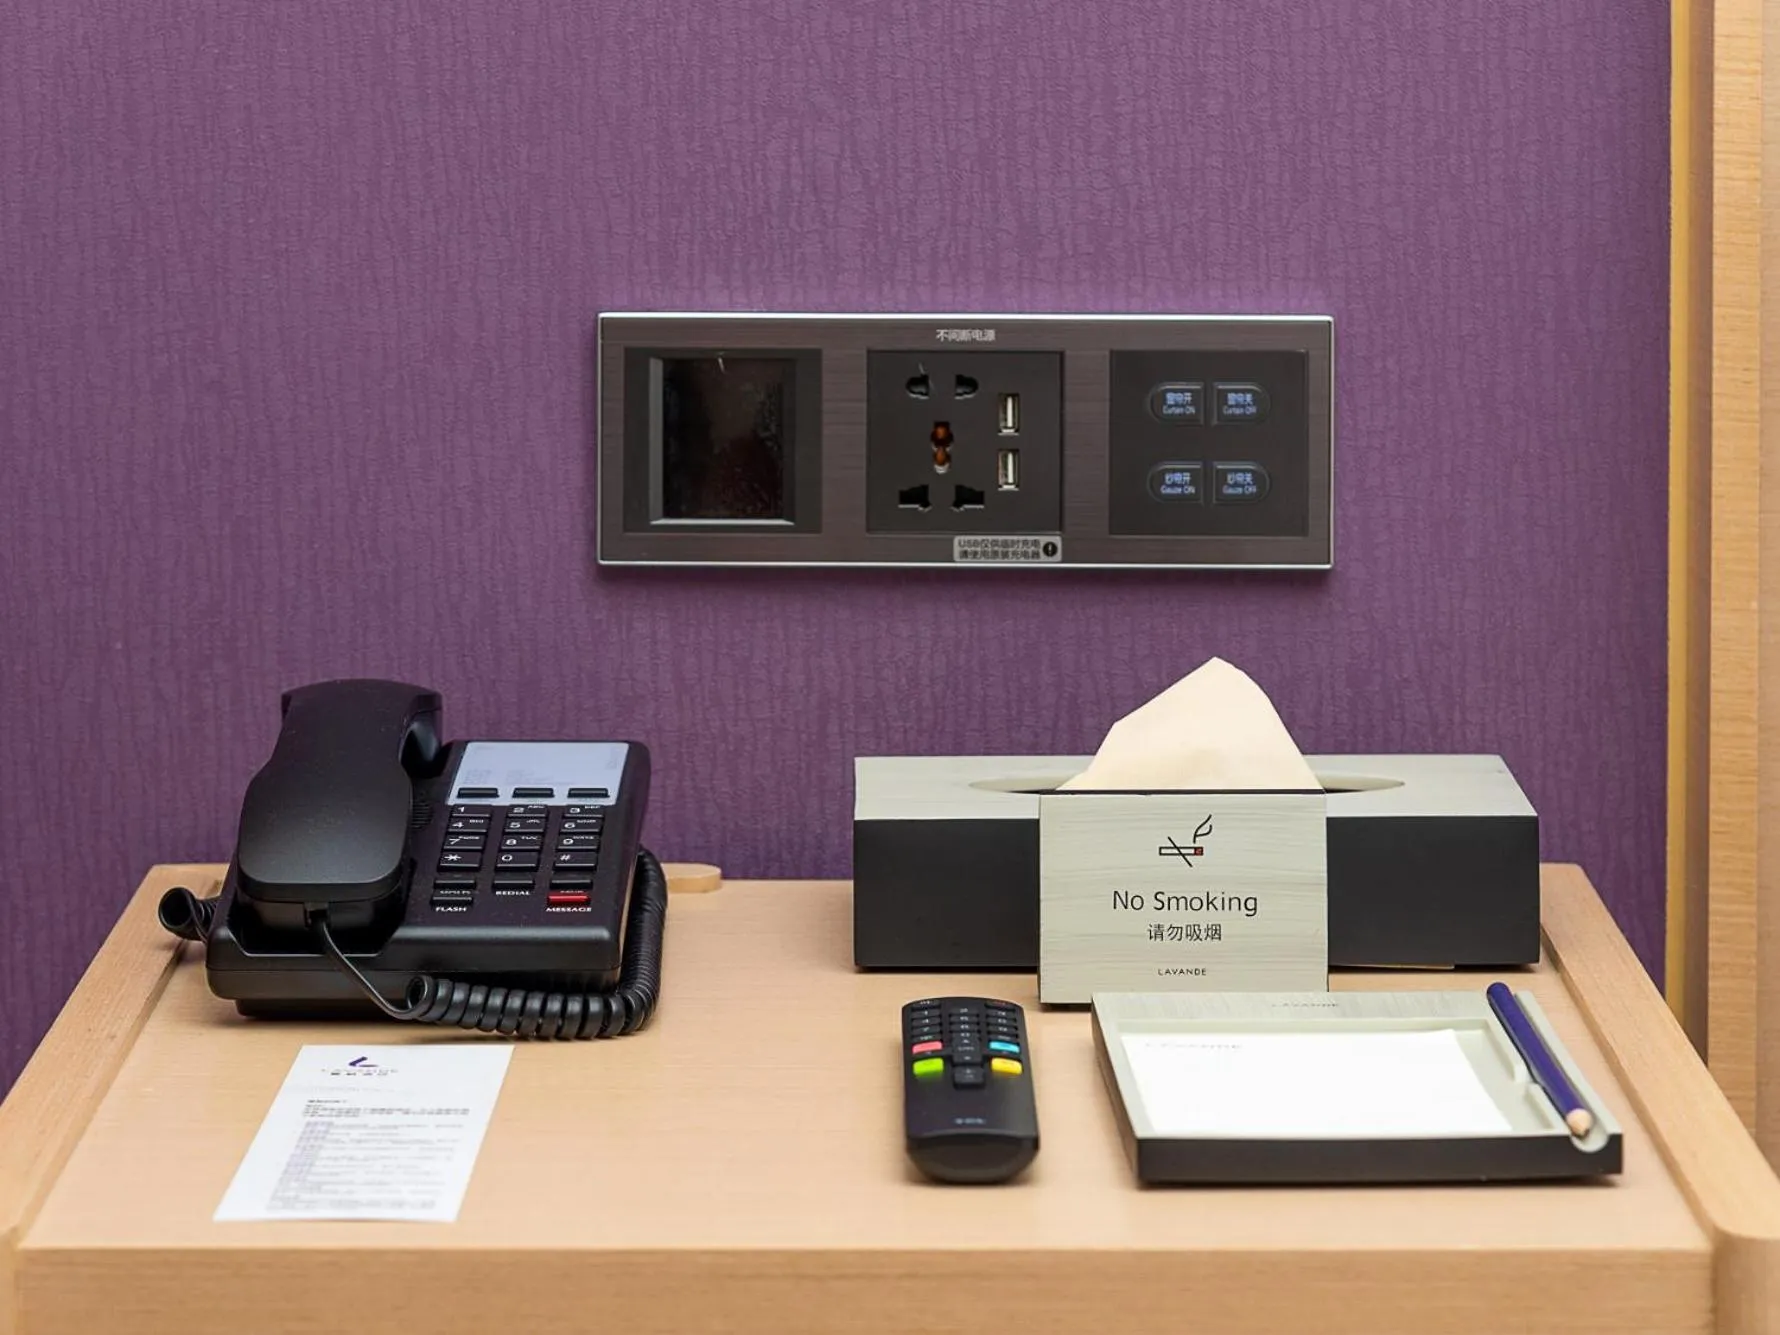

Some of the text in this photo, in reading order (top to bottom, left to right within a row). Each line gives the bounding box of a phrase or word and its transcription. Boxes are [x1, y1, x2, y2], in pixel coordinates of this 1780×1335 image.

[936, 329, 996, 342] 不间断电源
[1185, 405, 1196, 415] ON
[1183, 485, 1196, 494] ON
[1112, 890, 1258, 917] No Smoking
[1148, 923, 1222, 942] 请勿吸烟
[1157, 967, 1208, 976] LAVANDE
